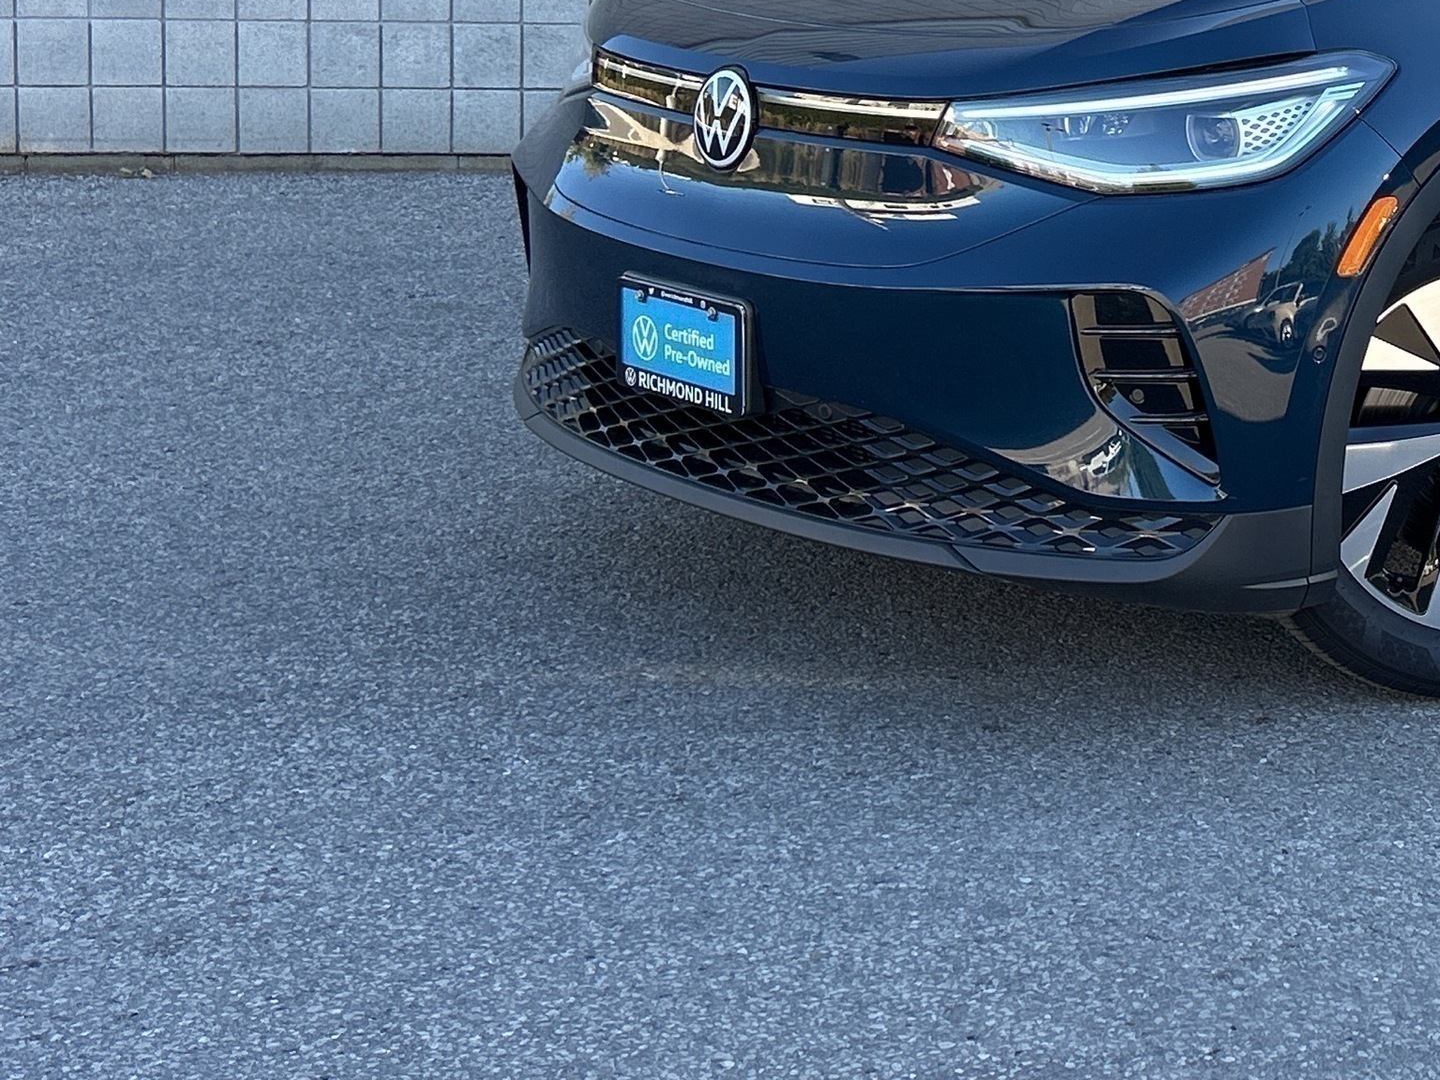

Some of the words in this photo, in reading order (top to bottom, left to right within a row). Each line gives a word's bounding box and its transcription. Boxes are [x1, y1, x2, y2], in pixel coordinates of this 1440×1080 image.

[694, 69, 751, 167] VW
[632, 315, 658, 361] VW
[664, 323, 715, 351] Certified
[664, 344, 731, 377] Pre-Owned
[638, 371, 703, 404] RICHMOND
[705, 390, 733, 414] HILL
